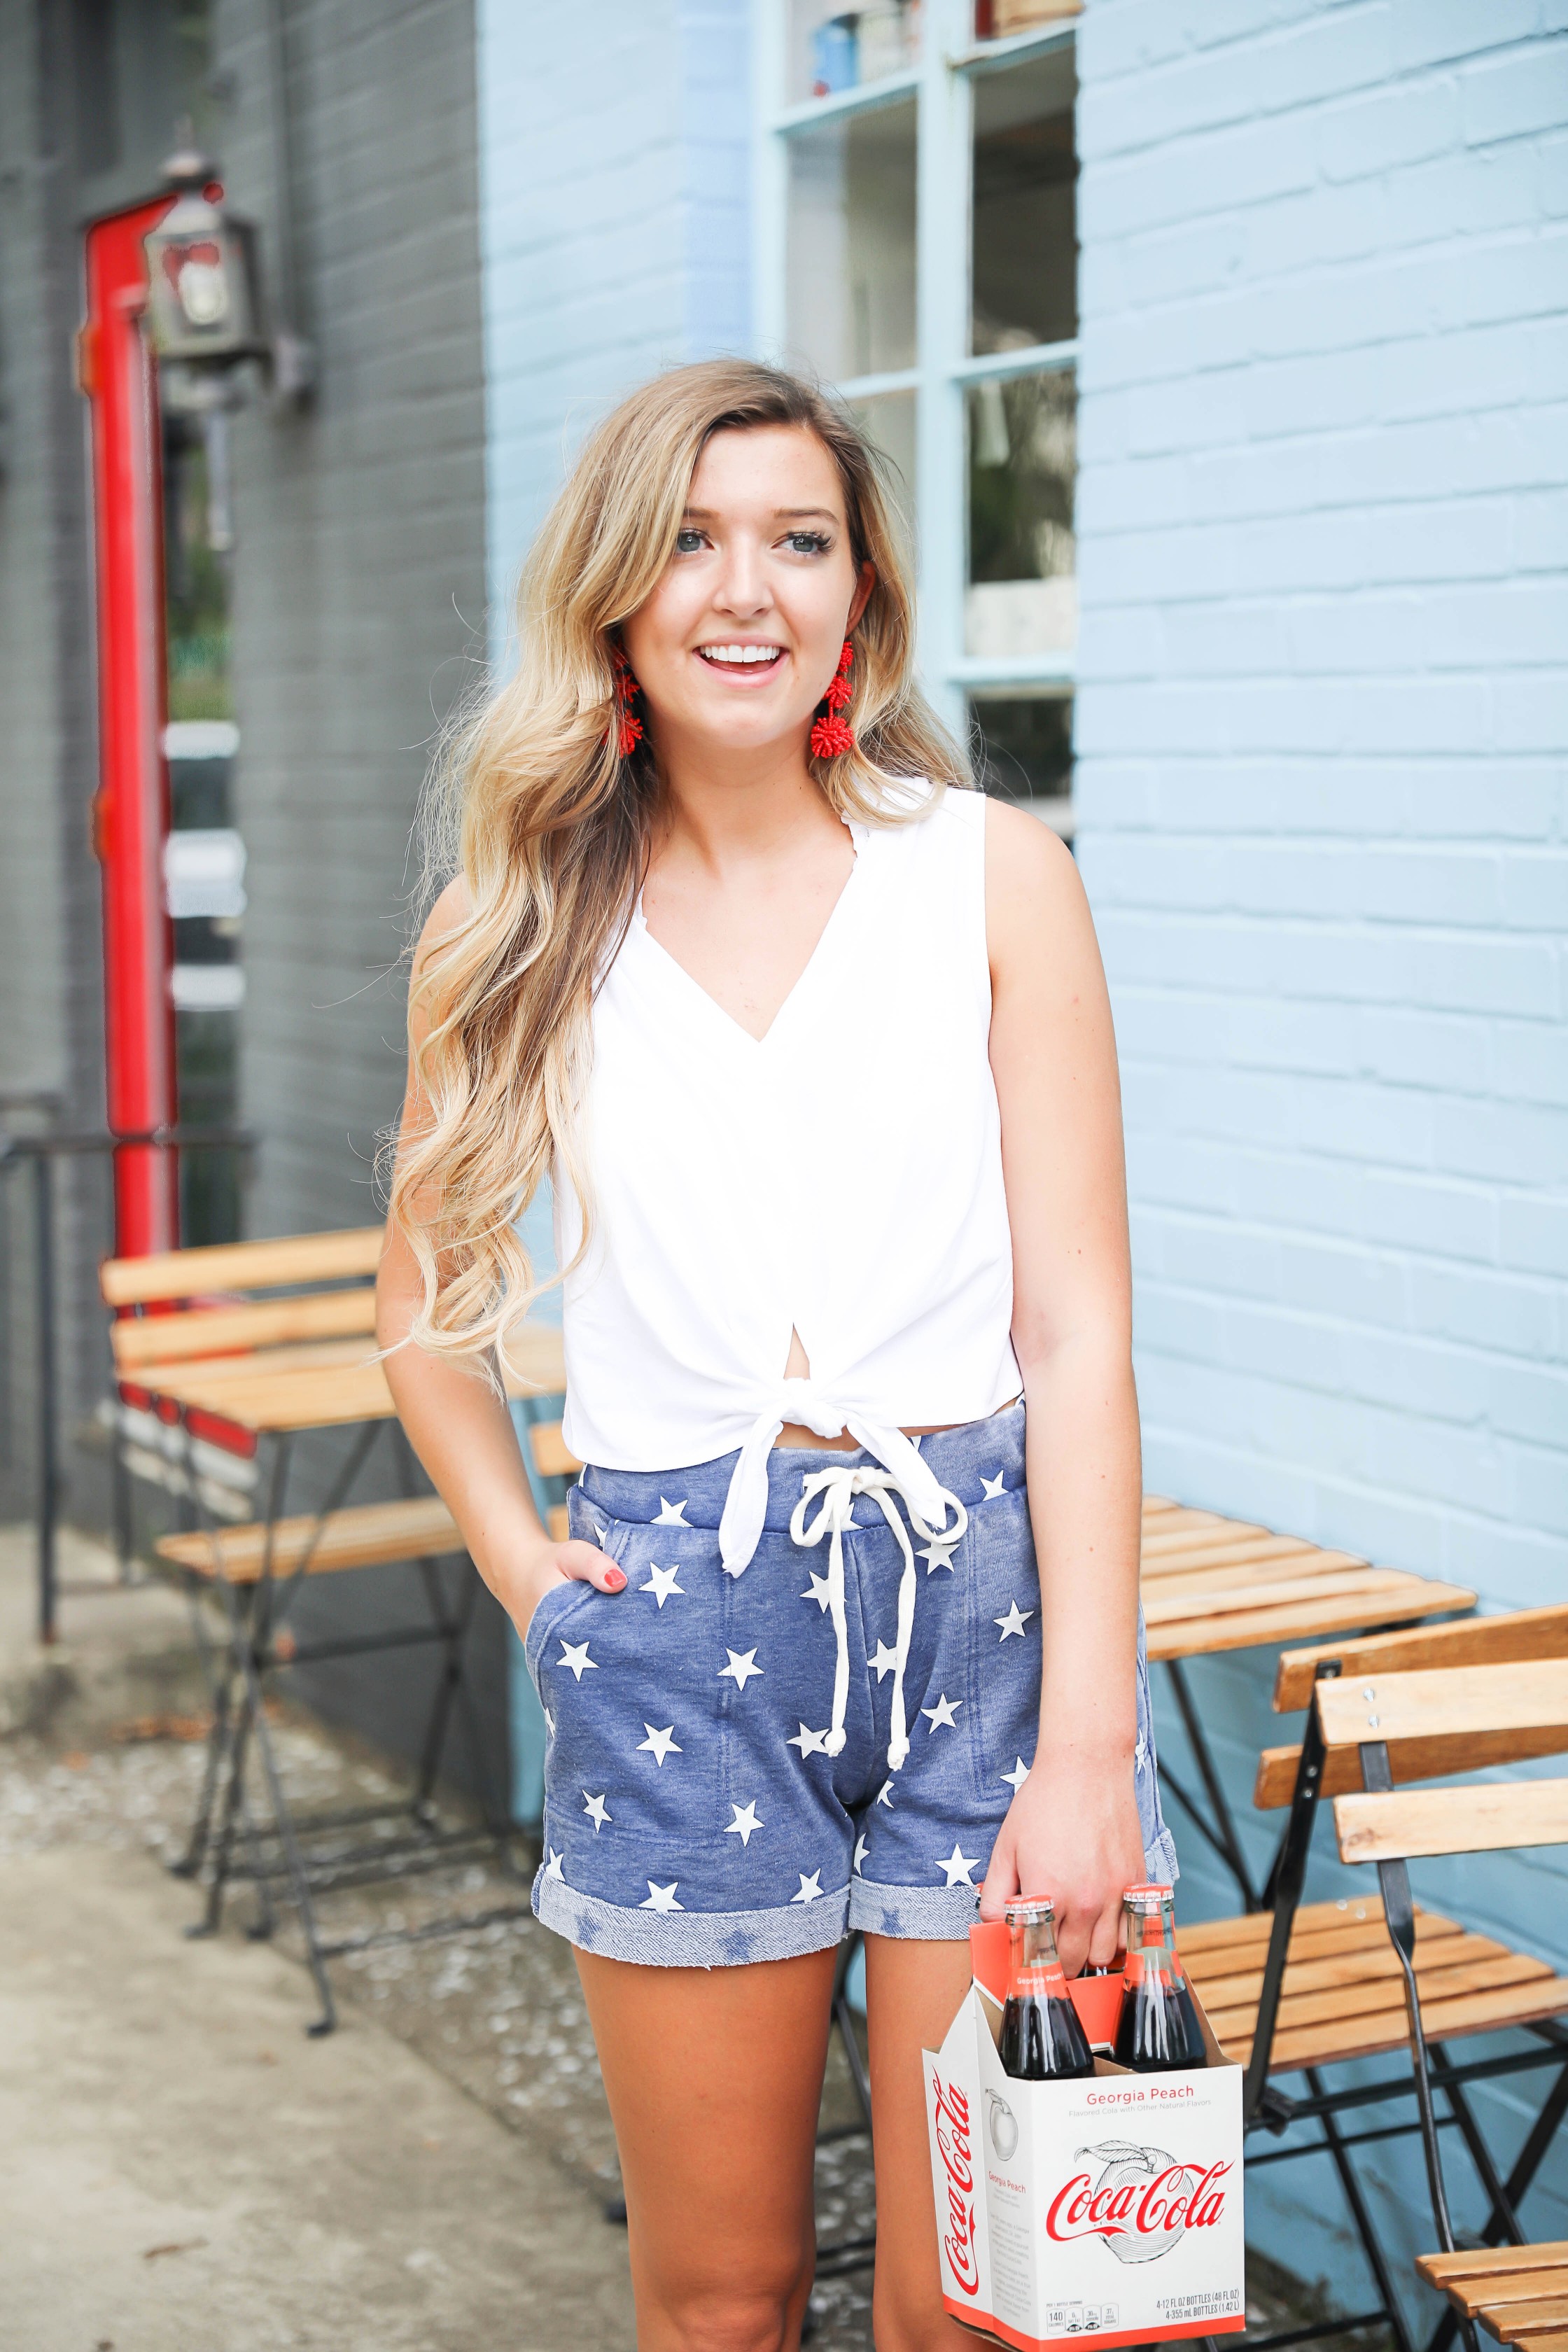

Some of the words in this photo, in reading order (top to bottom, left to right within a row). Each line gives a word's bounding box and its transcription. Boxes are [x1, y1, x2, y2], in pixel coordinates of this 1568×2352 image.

[1017, 1977, 1044, 1985] Georgia
[1086, 2090, 1145, 2105] Georgia
[1150, 2085, 1194, 2099] Peach
[1069, 2108, 1100, 2118] Flavored
[1102, 2107, 1118, 2115] Cola
[1159, 2101, 1185, 2110] Natural
[1186, 2099, 1212, 2108] Flavors
[932, 2064, 979, 2296] Coca-Cola
[988, 2171, 1006, 2187] Georgia
[1007, 2180, 1026, 2194] Peach
[1046, 2159, 1236, 2242] Coca-Cola
[1156, 2299, 1170, 2309] 4-12
[1170, 2298, 1177, 2308] FL
[1178, 2297, 1186, 2306] OZ
[1186, 2293, 1211, 2305] BOTTLES
[1212, 2291, 1222, 2302] (48
[1223, 2290, 1229, 2300] FL
[1230, 2288, 1240, 2299] OZ)
[1049, 2311, 1063, 2322] 140
[1166, 2309, 1183, 2320] 4-355
[1184, 2307, 1191, 2317] mL
[1194, 2304, 1218, 2316] BOTTLES
[1219, 2302, 1233, 2313] (1.42
[1234, 2299, 1240, 2311] L)
